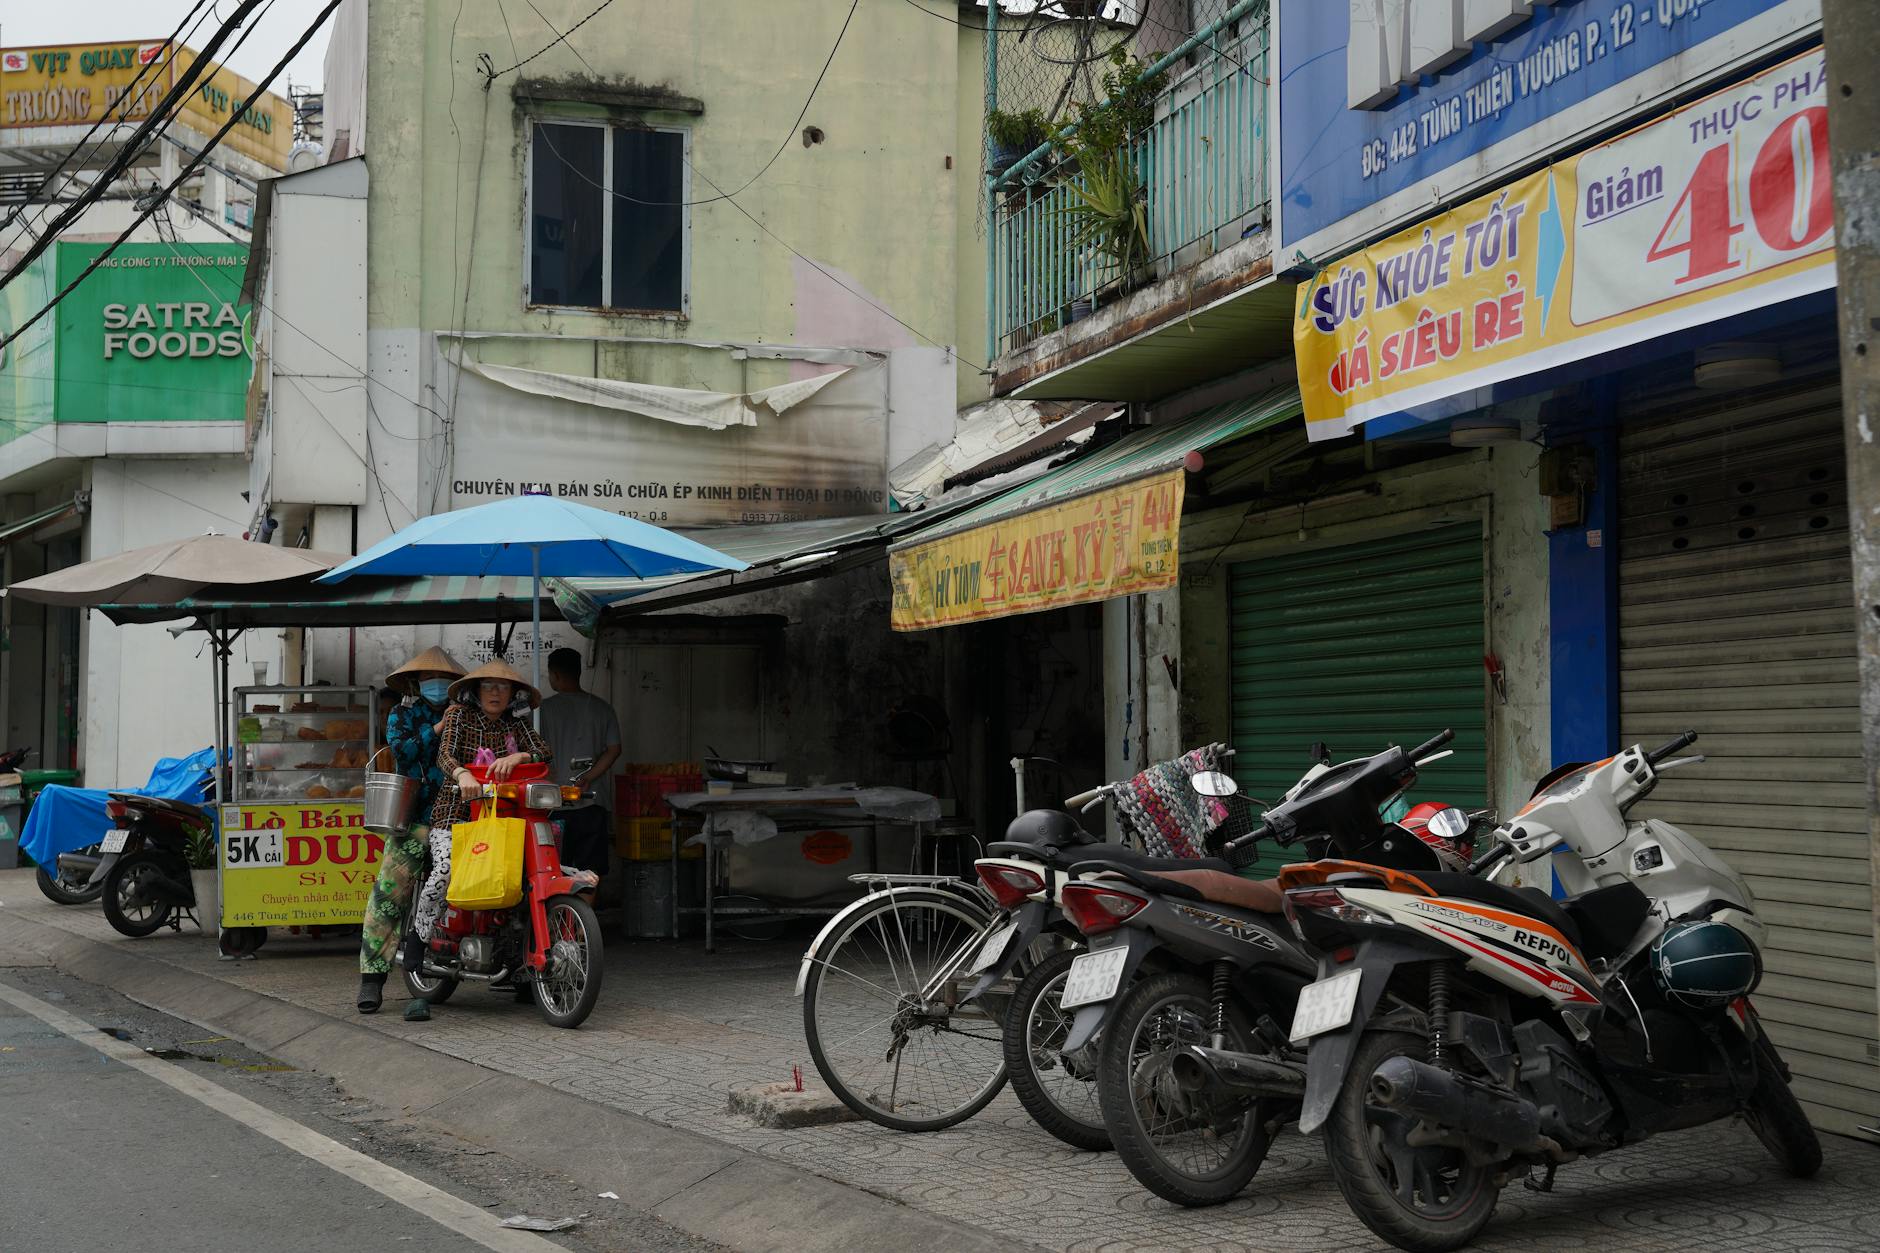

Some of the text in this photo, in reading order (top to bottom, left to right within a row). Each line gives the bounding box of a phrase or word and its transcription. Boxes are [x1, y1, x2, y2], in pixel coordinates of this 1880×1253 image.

[33, 48, 137, 79] VỊT QUAY
[1389, 119, 1418, 163] 442
[1420, 97, 1462, 148] TÙNG
[1465, 64, 1514, 122] THIỆN
[1518, 30, 1582, 98] VƯƠNG
[1610, 3, 1635, 50] 12
[1689, 95, 1763, 145] THỰC
[1586, 165, 1663, 220] Giảm
[1647, 106, 1835, 286] 40
[121, 254, 151, 268] CÔNG
[154, 257, 167, 267] TY
[217, 255, 237, 268] MẠI
[1375, 226, 1456, 311] KHỎE
[1463, 190, 1526, 277] TỐT
[103, 303, 242, 329] SATRA
[1379, 307, 1462, 379] SIÊU
[1473, 273, 1525, 351] RẺ
[103, 332, 242, 358] FOODS
[453, 479, 514, 496] CHUYÊN
[558, 481, 588, 497] BÁN
[593, 479, 623, 498] SỬA
[628, 482, 668, 499] CHỮA
[673, 482, 692, 499] ÉP
[697, 486, 732, 500] KINH
[737, 484, 772, 504] ĐIỆN
[776, 487, 820, 504] THOẠI
[1008, 529, 1067, 597] SANH
[1072, 500, 1107, 586] KÝ
[240, 811, 286, 831] Lò
[227, 836, 260, 864] 5K
[270, 835, 276, 846] 1
[265, 848, 281, 863] CÁI
[262, 893, 299, 906] Chuyên
[304, 891, 329, 905] nhận
[233, 912, 254, 922] 446
[258, 911, 288, 922] Tùng
[292, 908, 326, 919] Thiện
[1513, 929, 1573, 967] REPSOL
[1549, 979, 1576, 994] MOTUL
